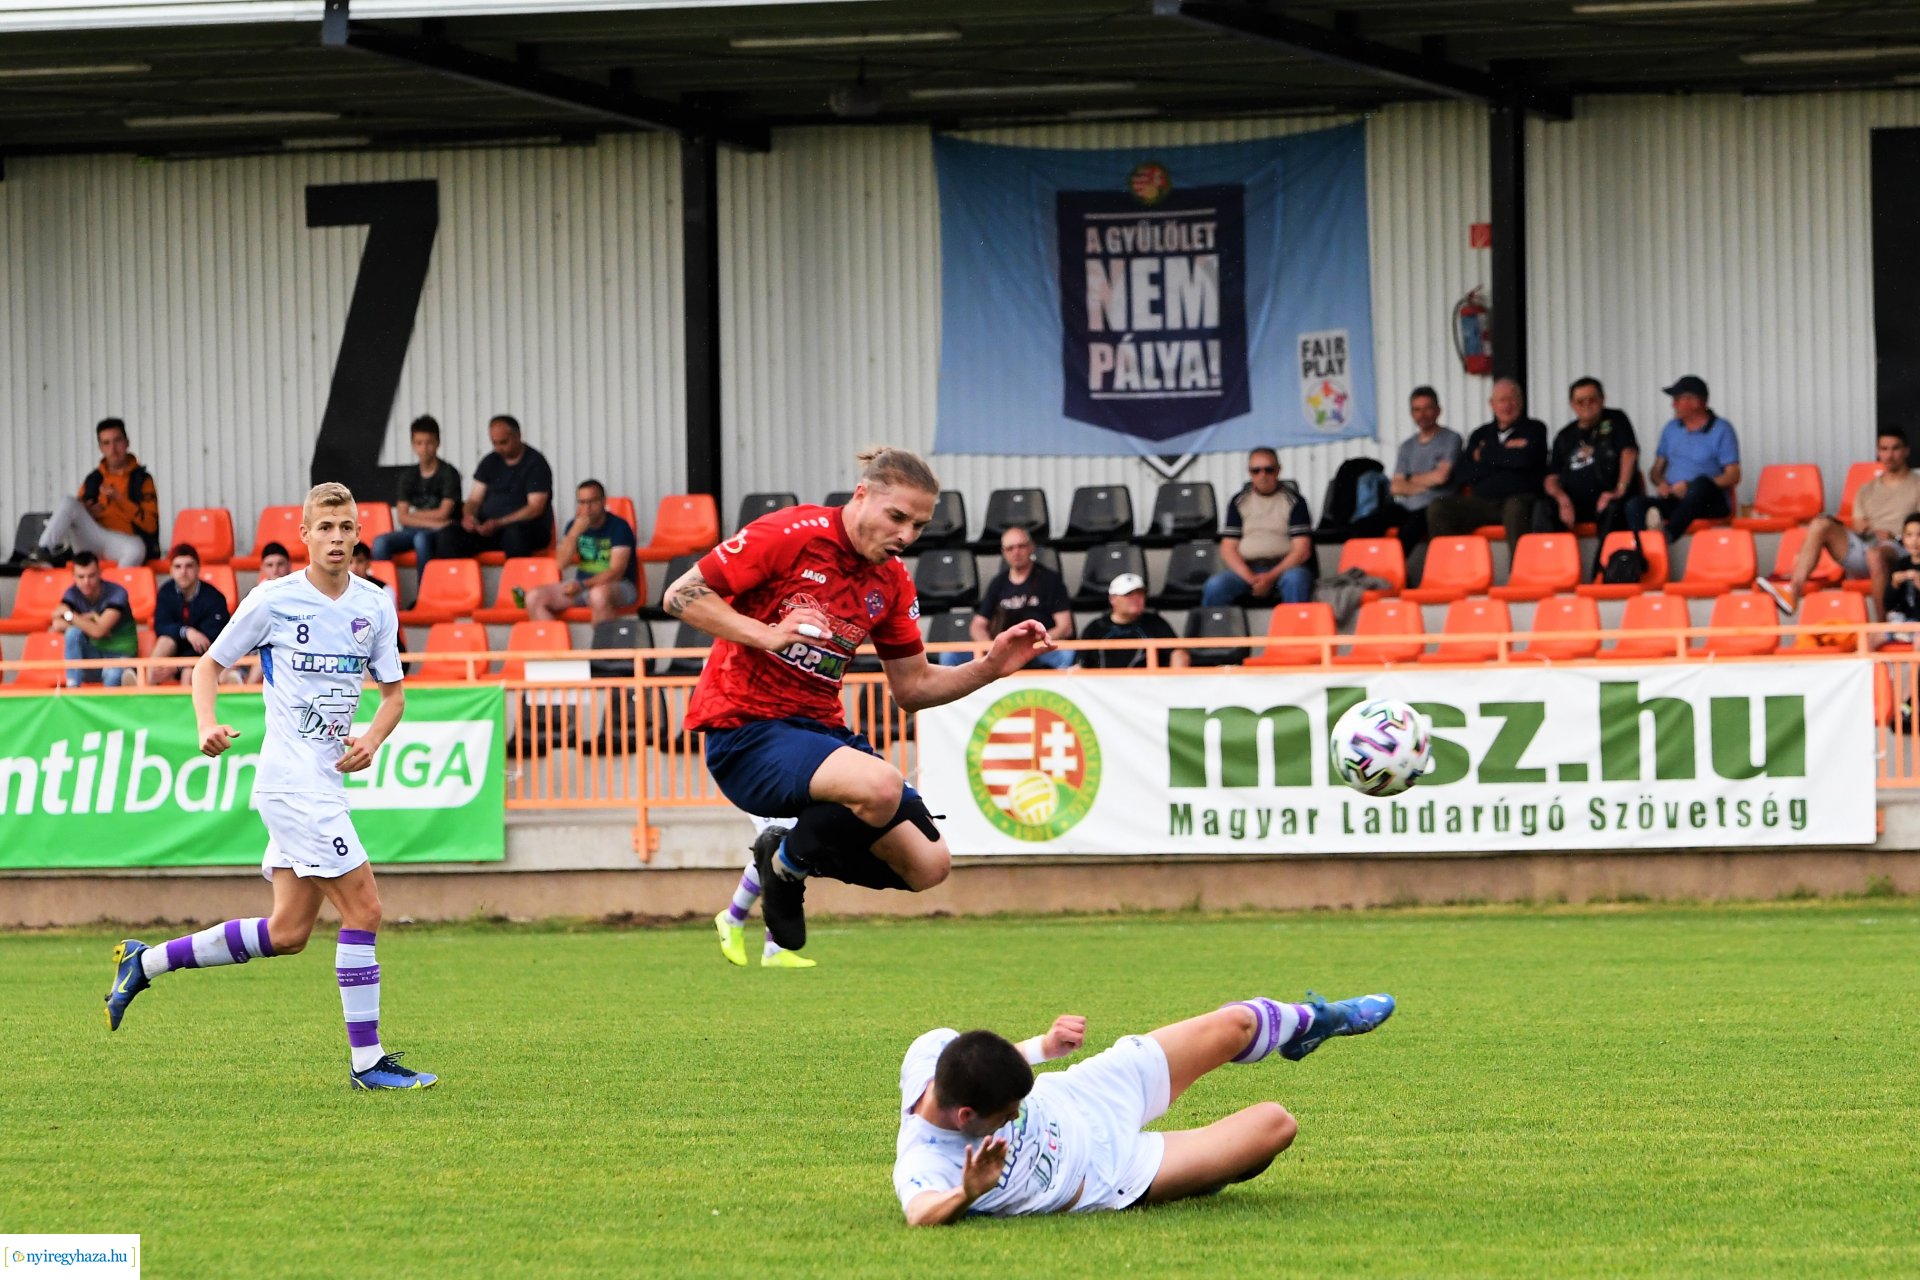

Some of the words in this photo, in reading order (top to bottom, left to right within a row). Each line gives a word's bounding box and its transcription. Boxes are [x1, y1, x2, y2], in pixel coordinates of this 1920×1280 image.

[1085, 226, 1101, 254] A
[1085, 254, 1219, 332] NEM
[1302, 337, 1345, 359] FAIR
[1088, 333, 1222, 391] PÁLYA!
[1303, 358, 1345, 378] PLAY
[801, 568, 827, 584] JAKO
[296, 623, 310, 645] 8
[1170, 803, 1318, 839] Magyar
[1343, 797, 1565, 836] Labdarúgó
[1589, 792, 1807, 830] Szövetség
[332, 836, 349, 856] 8
